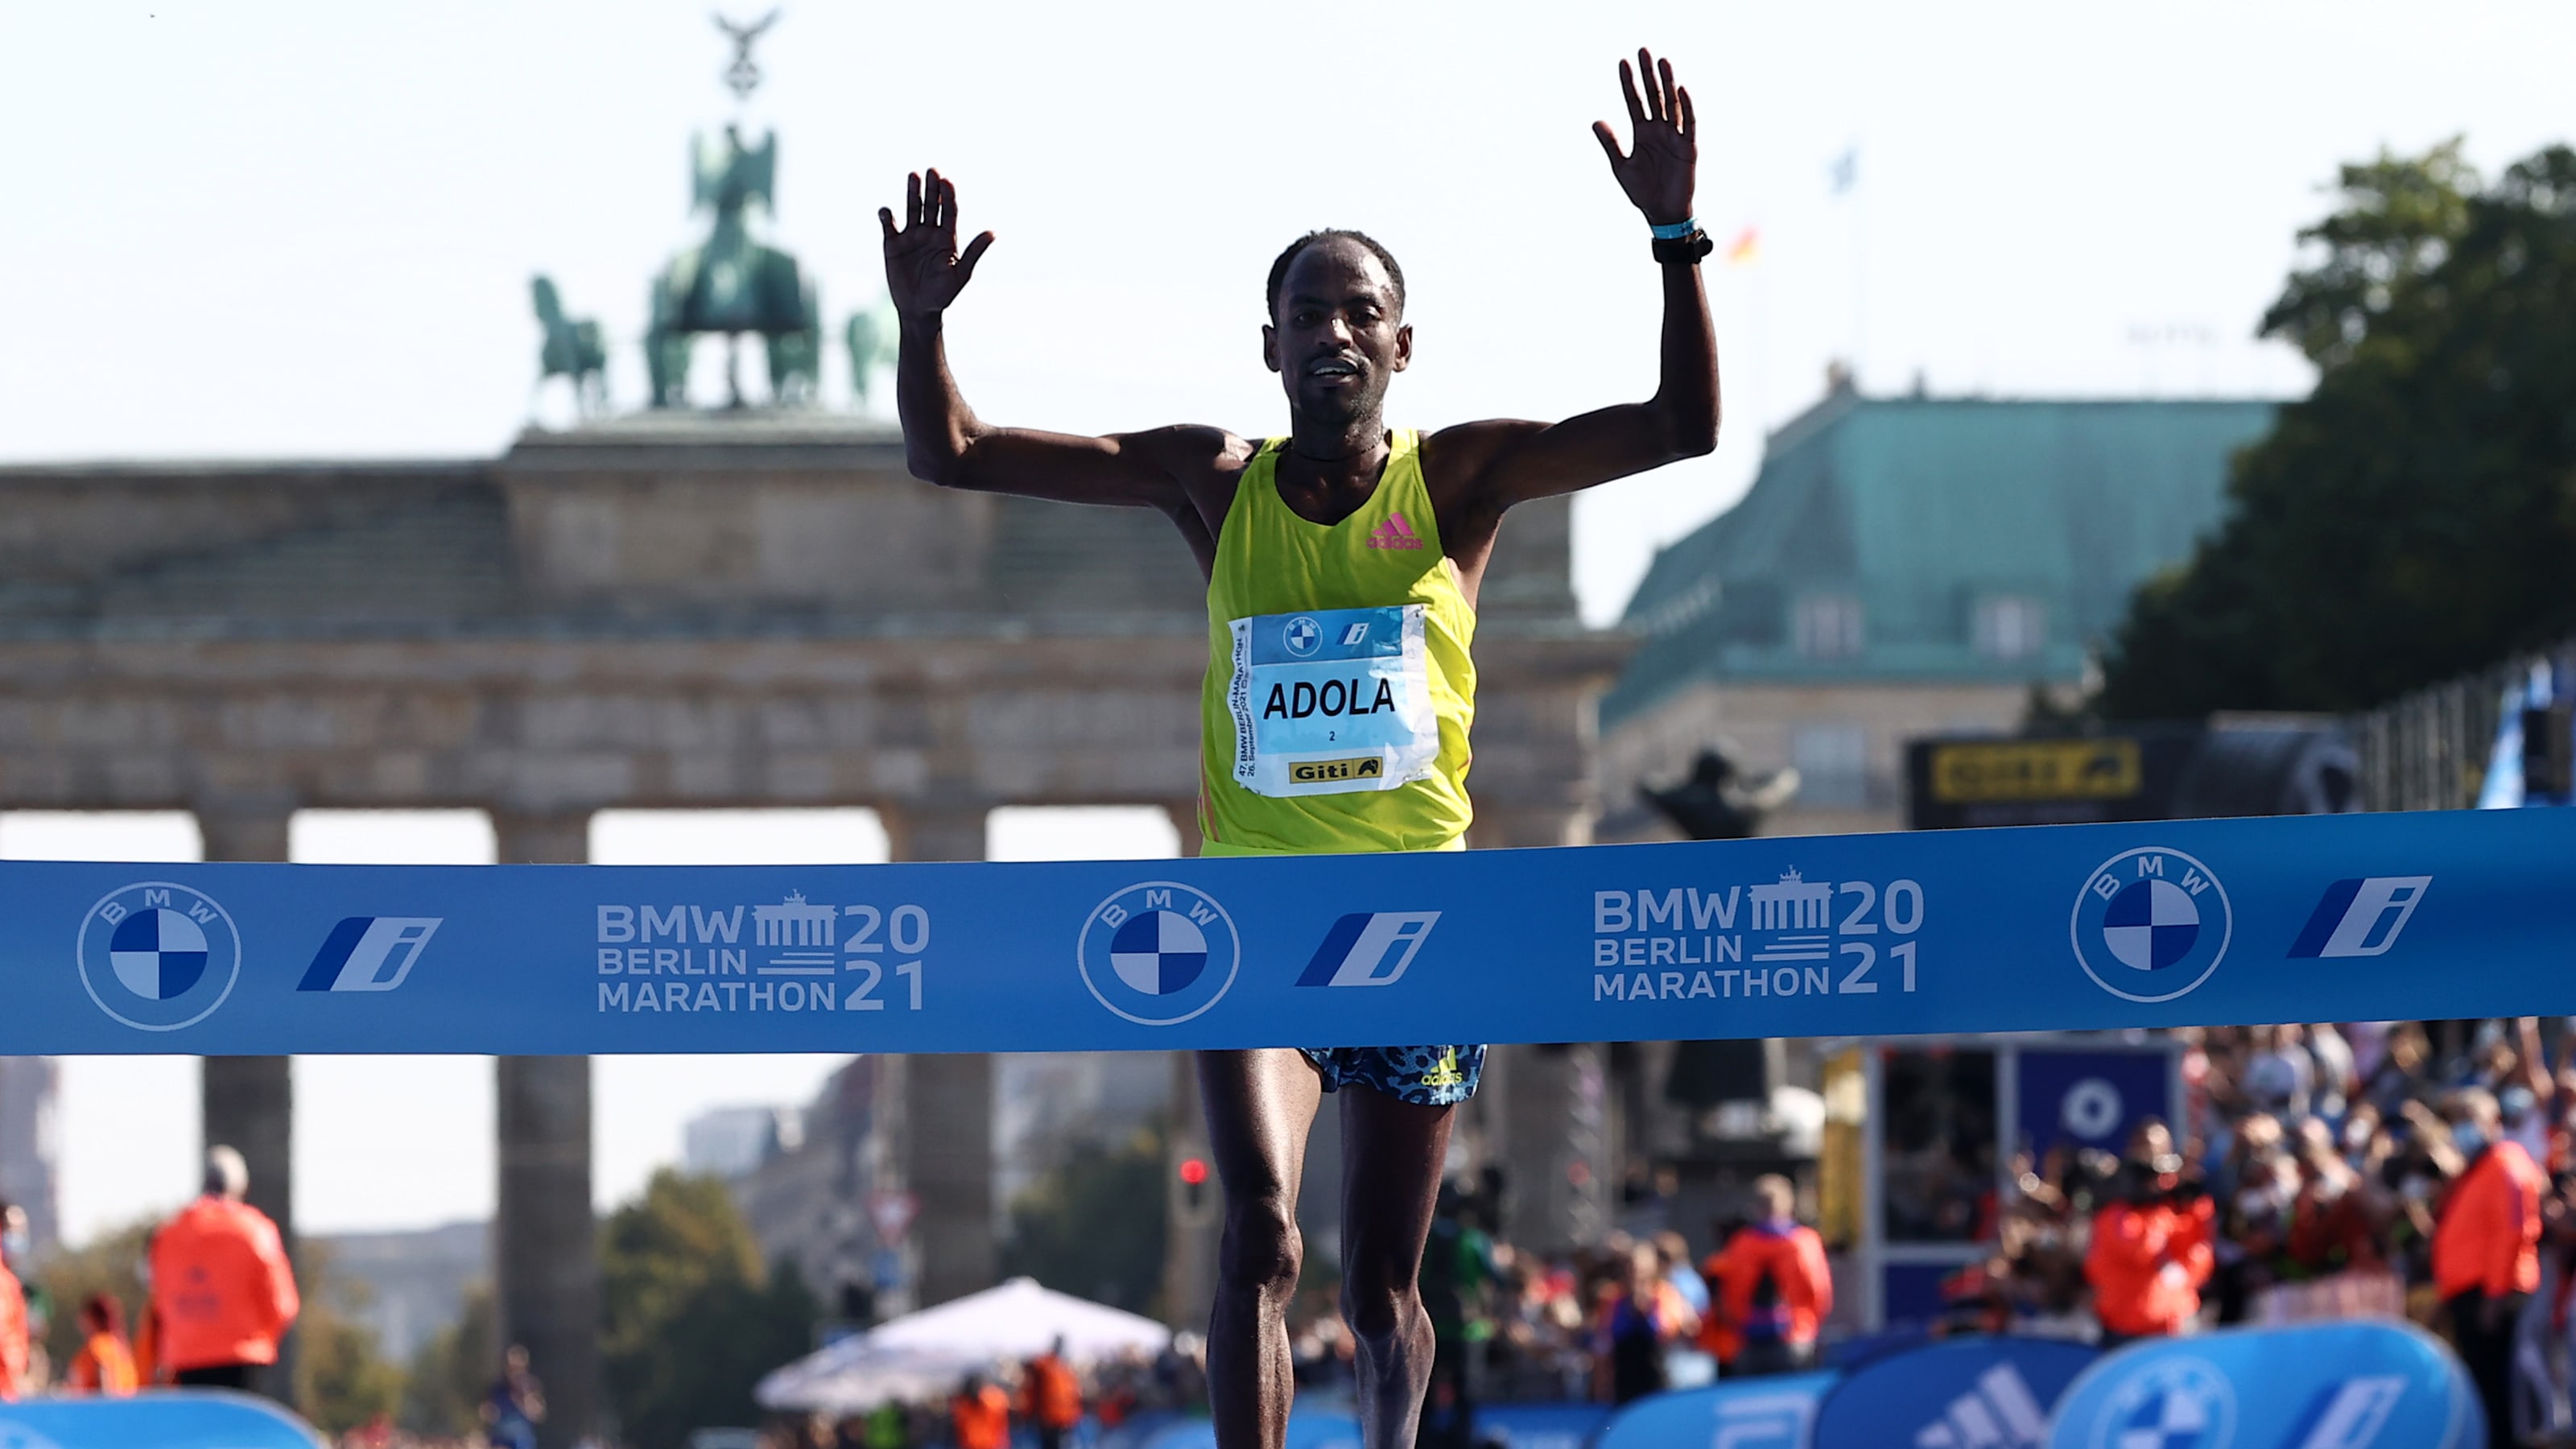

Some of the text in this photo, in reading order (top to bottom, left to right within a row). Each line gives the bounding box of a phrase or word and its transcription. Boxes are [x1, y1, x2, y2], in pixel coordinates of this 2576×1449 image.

[1366, 535, 1424, 550] adidas
[1240, 691, 1249, 712] 2021
[1263, 678, 1395, 720] ADOLA
[1239, 736, 1249, 762] BMW
[1329, 731, 1335, 741] 2
[1239, 763, 1247, 777] 47.
[1295, 763, 1348, 779] Giti
[2093, 856, 2210, 901] BMW
[99, 888, 217, 926] BMW
[597, 905, 745, 943] BMW
[1100, 890, 1217, 928] BMW
[1595, 886, 1740, 933] BMW
[1839, 879, 1924, 935] 20
[844, 904, 930, 955] 20
[598, 948, 746, 975] BERLIN
[1595, 935, 1741, 967] BERLIN
[1839, 941, 1916, 995] 21
[598, 982, 835, 1013] MARATHON
[844, 960, 923, 1011] 21
[1594, 967, 1829, 1001] MARATHON
